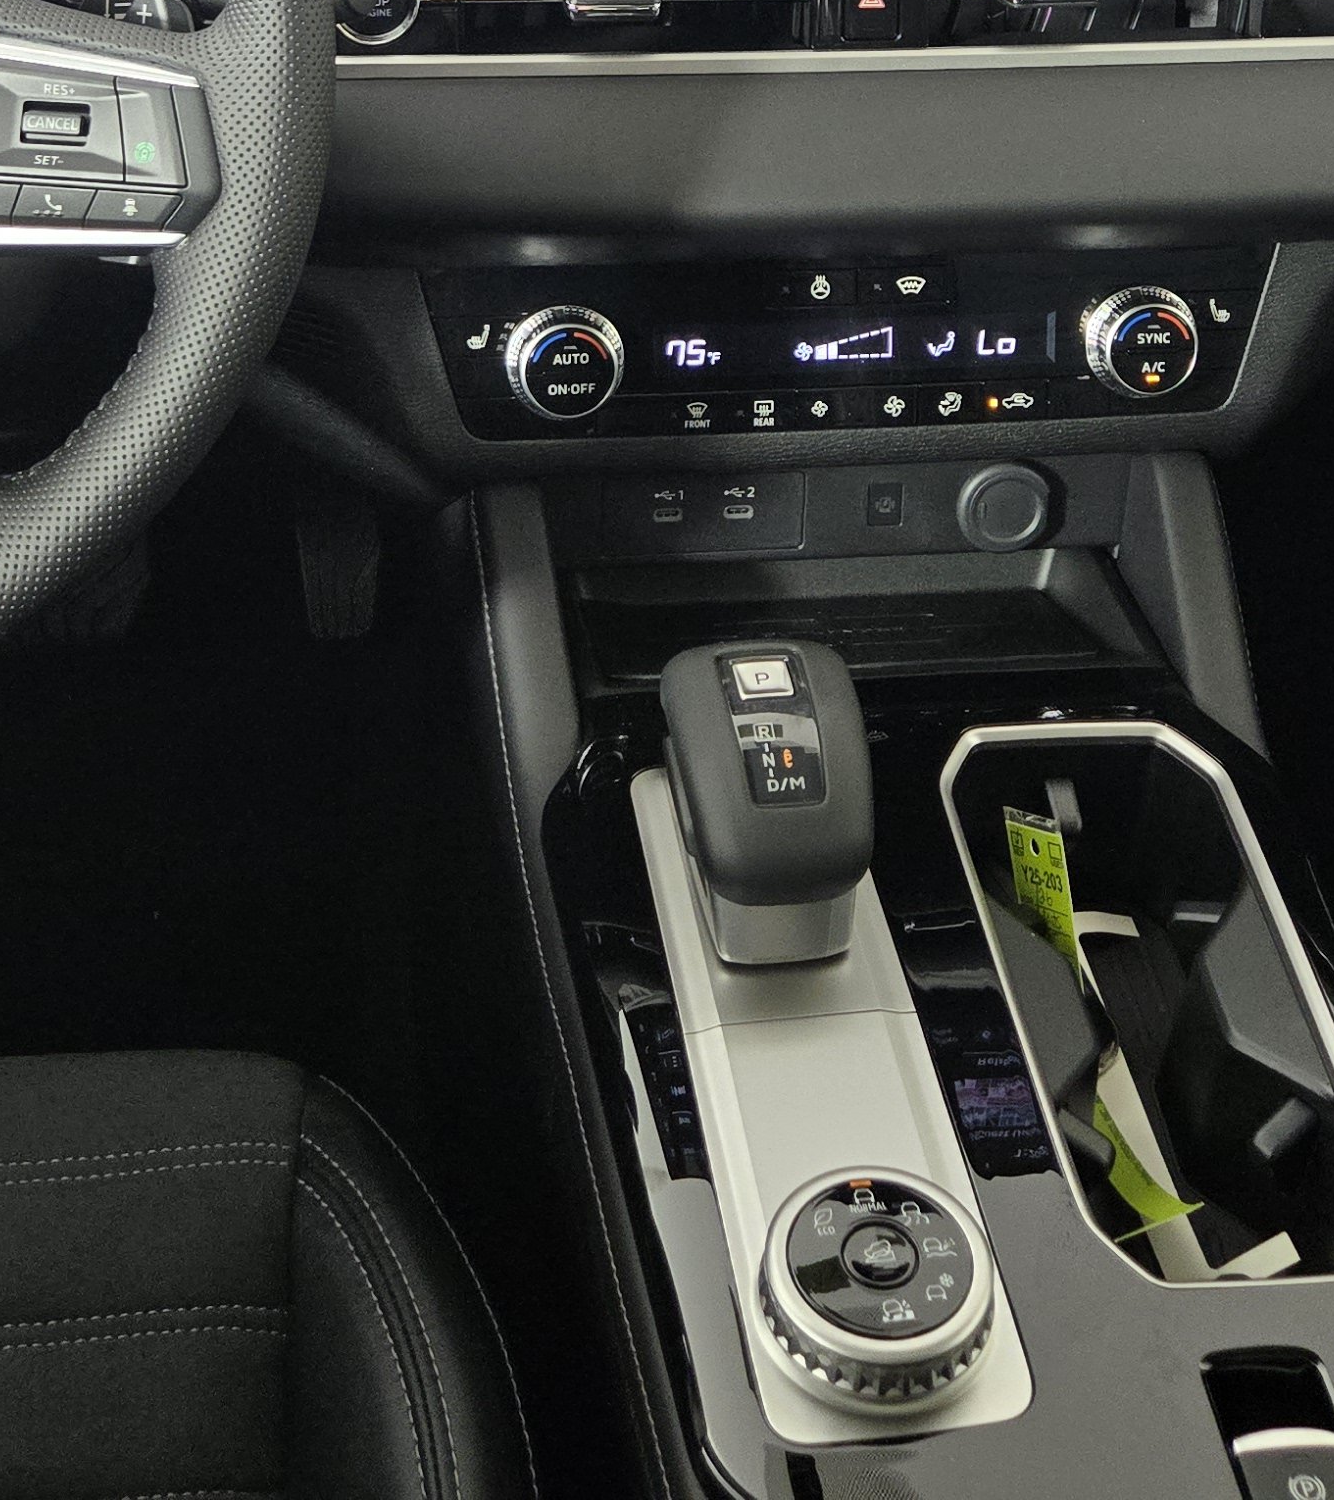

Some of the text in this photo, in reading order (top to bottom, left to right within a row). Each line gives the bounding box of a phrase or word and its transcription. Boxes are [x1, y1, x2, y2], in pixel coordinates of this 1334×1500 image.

[43, 83, 76, 96] RES+
[26, 115, 80, 132] CANCEL
[33, 154, 65, 166] SET-
[977, 329, 1017, 356] Lo
[1137, 332, 1171, 345] SYNC
[553, 353, 589, 366] AUTO
[1141, 361, 1166, 374] A/C
[684, 419, 711, 429] FRONT
[753, 417, 775, 427] REAR
[747, 486, 756, 498] 2
[754, 672, 770, 685] P
[758, 725, 770, 739] R
[762, 753, 776, 768] N
[767, 776, 806, 793] D/M
[817, 1226, 836, 1237] ECO
